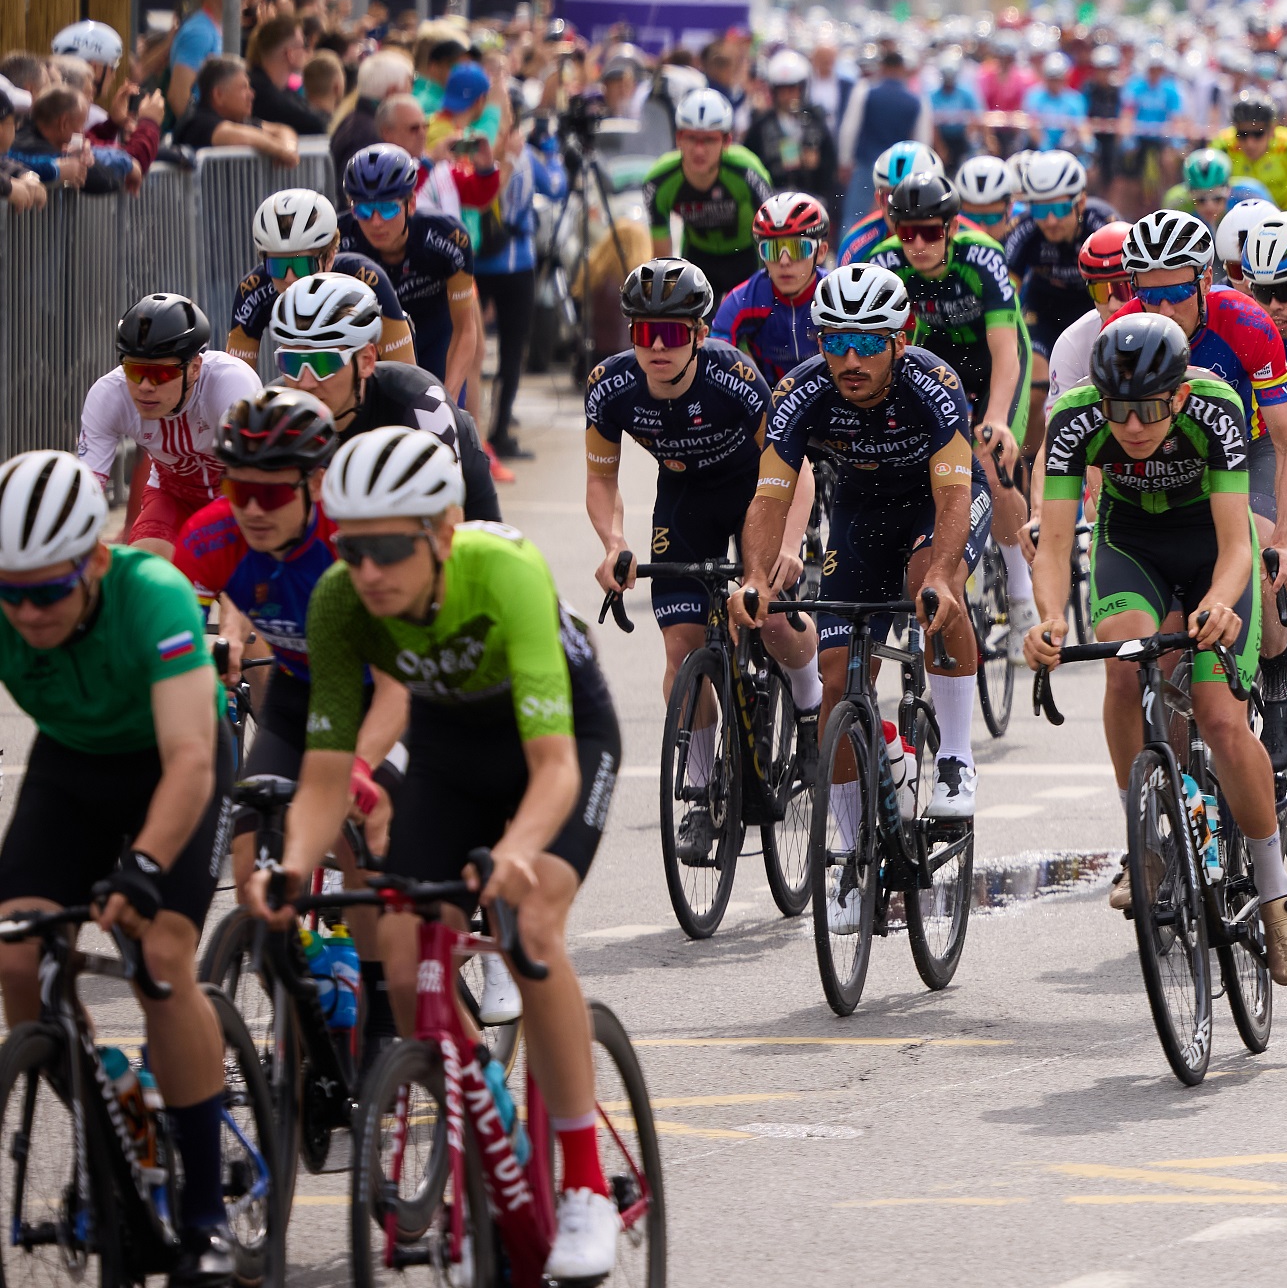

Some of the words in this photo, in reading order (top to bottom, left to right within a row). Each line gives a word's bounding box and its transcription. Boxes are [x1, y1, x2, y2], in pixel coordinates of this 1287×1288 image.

[966, 243, 1015, 302] RUSSIA
[234, 283, 277, 325] Капита
[705, 359, 764, 413] Капитал
[729, 360, 757, 383] АФ
[771, 377, 795, 408] АФ
[902, 362, 960, 427] Капитал
[927, 365, 959, 390] АФ
[766, 374, 830, 441] Капитал
[655, 427, 733, 449] Капитал
[851, 431, 931, 455] Капитал
[1047, 406, 1107, 473] RUSSIA
[1186, 395, 1247, 471] RUSSIA
[1100, 456, 1207, 479] ESTRORETSK
[461, 1060, 535, 1214] FACTOR
